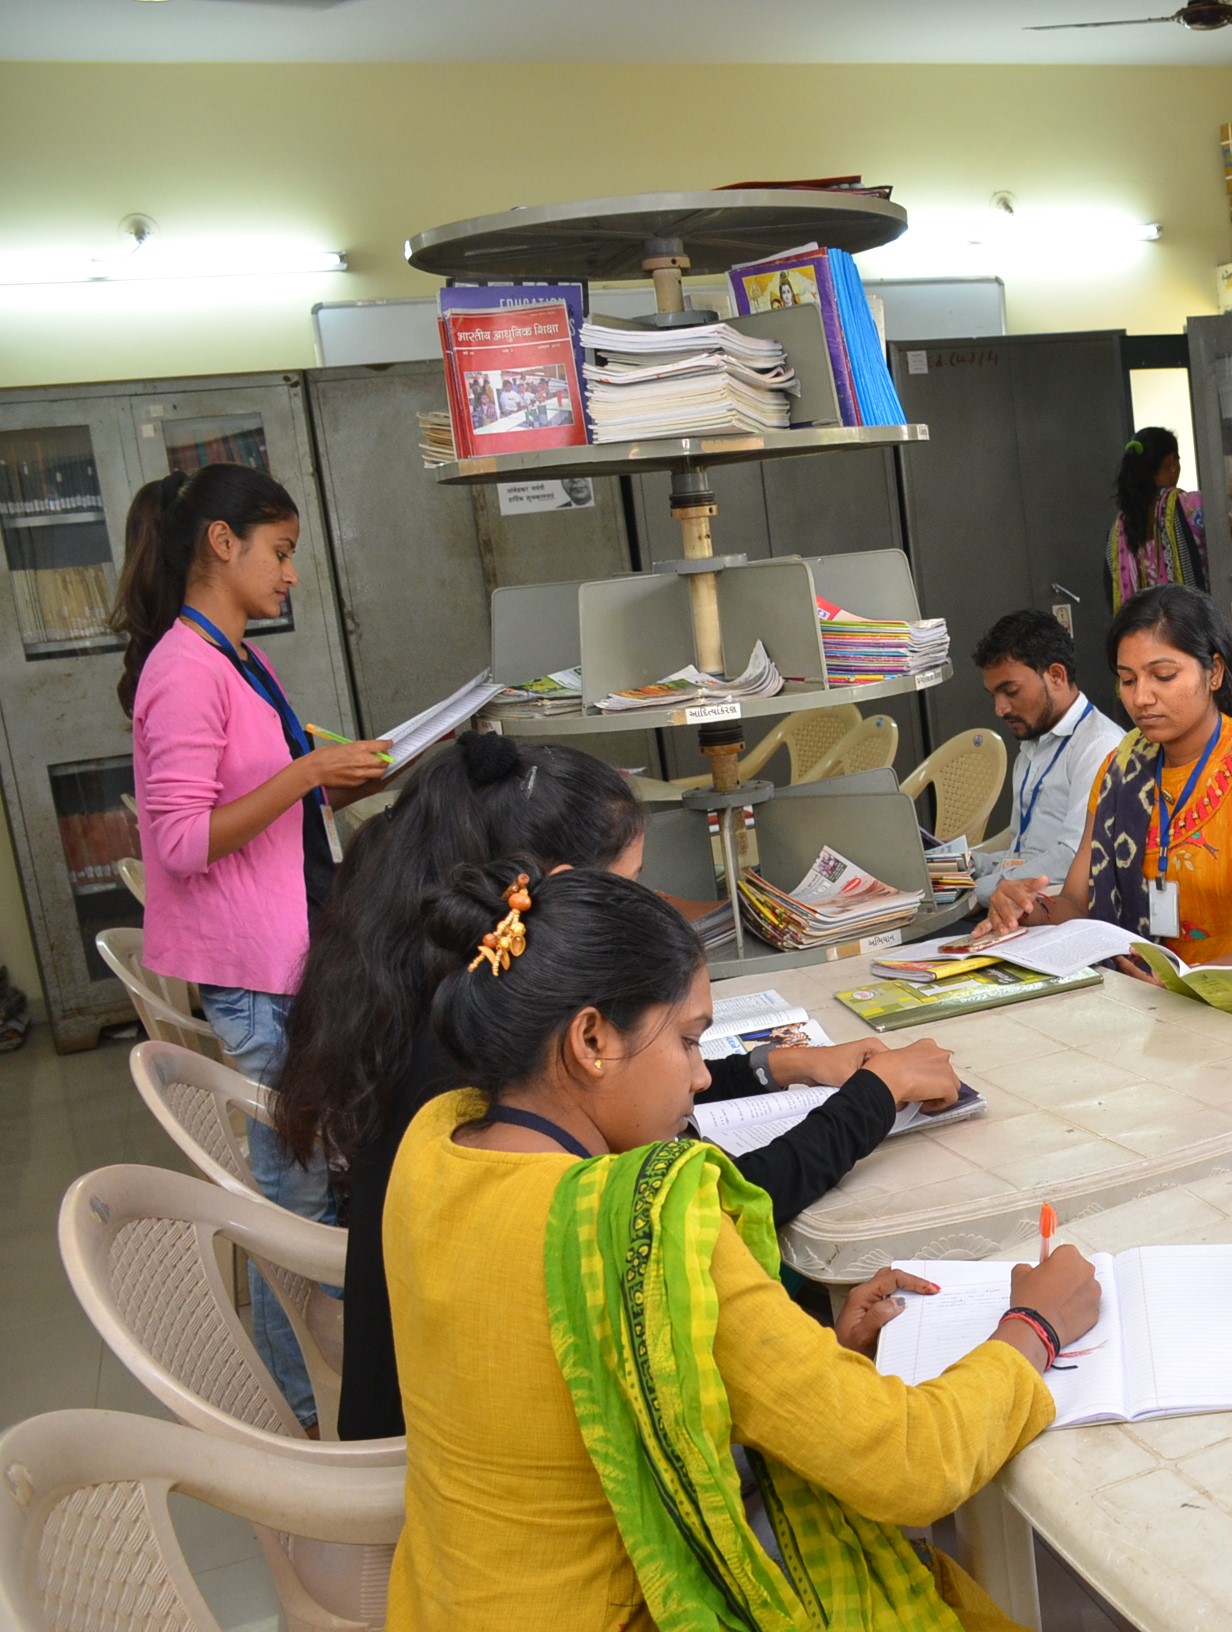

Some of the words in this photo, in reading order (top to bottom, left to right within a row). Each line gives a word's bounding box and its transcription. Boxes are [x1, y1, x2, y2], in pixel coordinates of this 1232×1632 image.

[499, 296, 566, 309] EDUCAT
[457, 328, 491, 342] भारतीय
[493, 325, 532, 343] आधुनिक
[534, 322, 560, 336] शिक्षा
